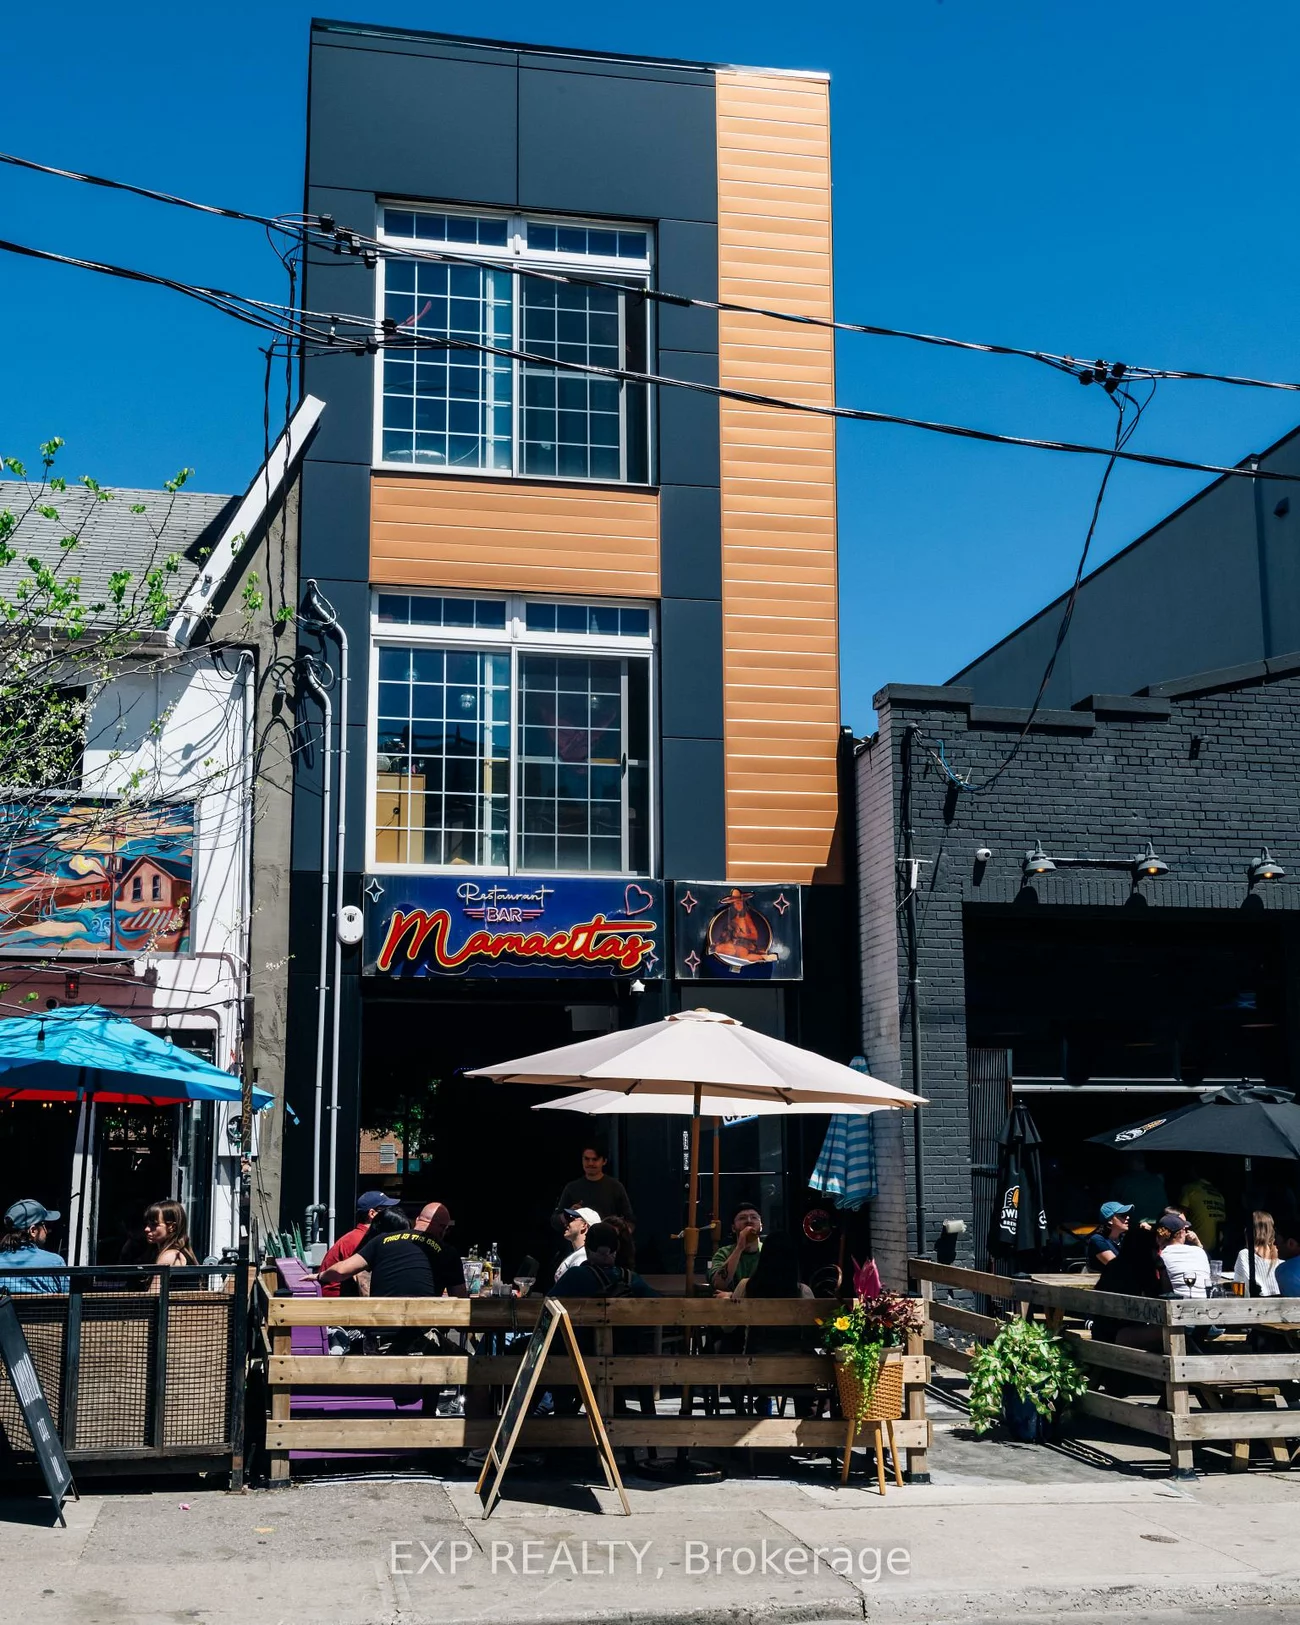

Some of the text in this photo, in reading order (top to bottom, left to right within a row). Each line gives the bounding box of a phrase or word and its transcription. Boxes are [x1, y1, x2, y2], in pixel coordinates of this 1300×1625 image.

[457, 883, 554, 908] Restaurant
[487, 907, 522, 922] BAR
[377, 908, 656, 971] Mamacitas
